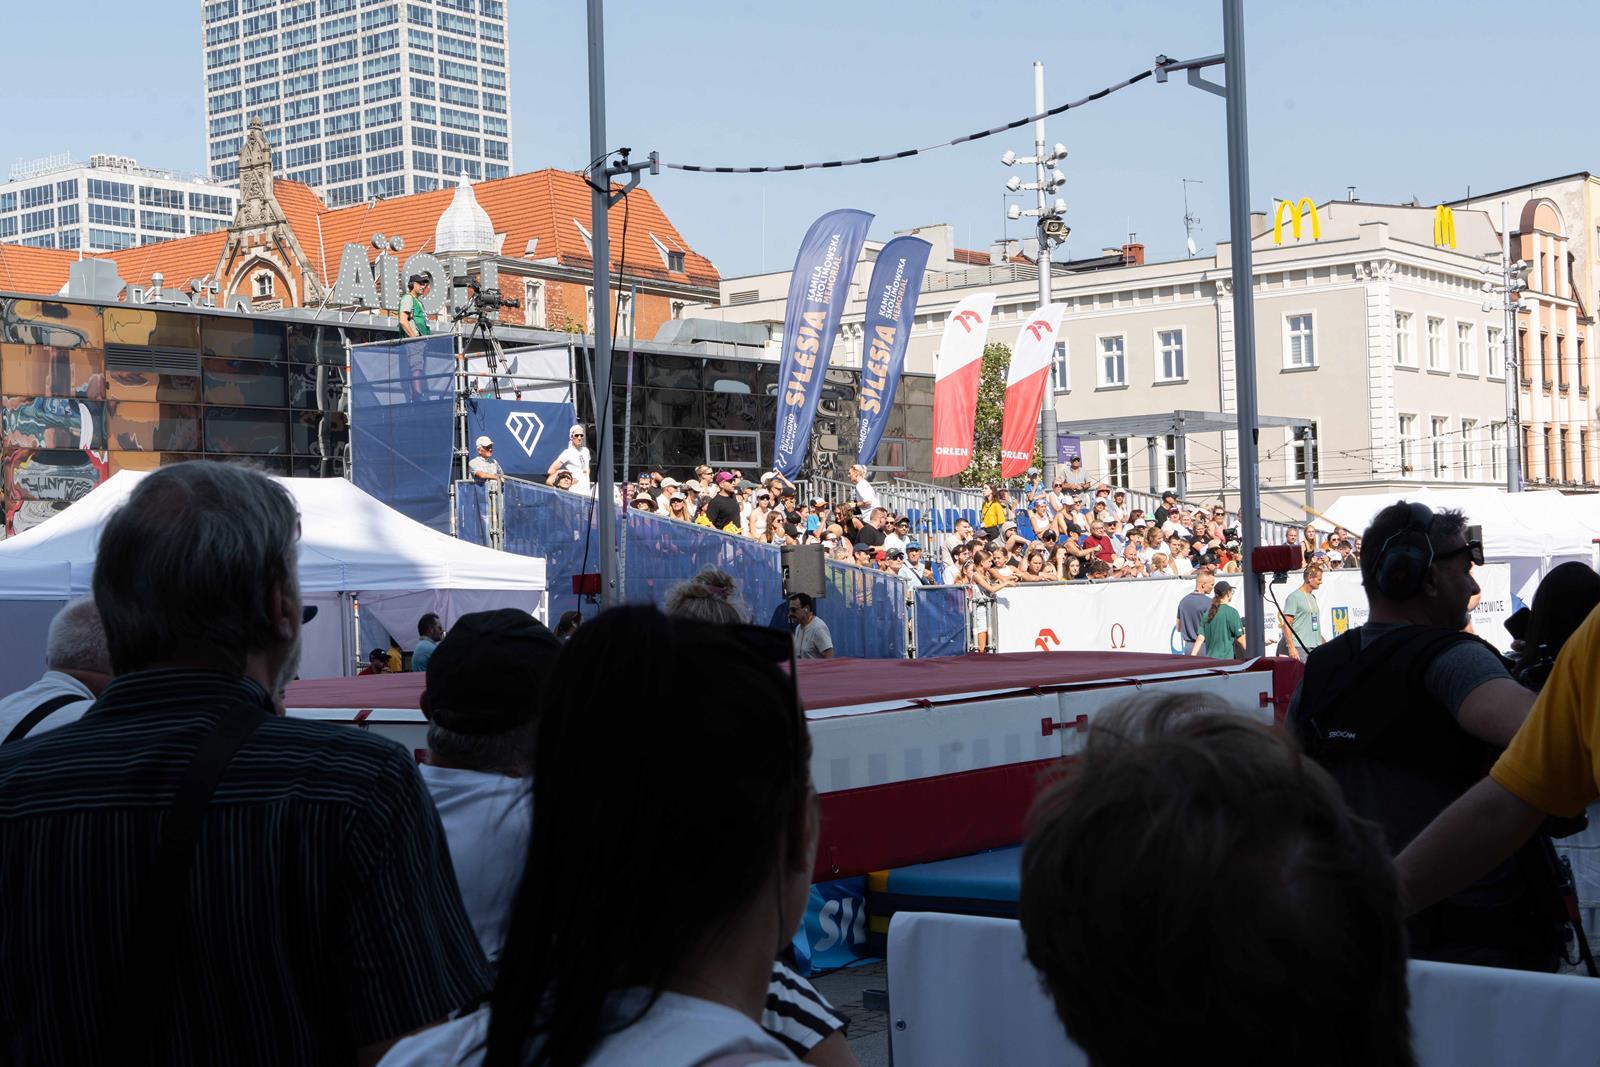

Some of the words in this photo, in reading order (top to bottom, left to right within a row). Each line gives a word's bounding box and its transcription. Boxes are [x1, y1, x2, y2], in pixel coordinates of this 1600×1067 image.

[806, 266, 823, 301] KAMILA
[815, 234, 840, 303] SKOLIMOWSKA
[823, 255, 842, 304] MEMORIAL
[886, 258, 906, 320] SKOLIMOWSKA
[879, 285, 892, 317] KAMILA
[892, 277, 908, 321] MEMORIAL
[786, 312, 827, 408] SILESIA
[859, 325, 897, 415] SILESIA
[935, 446, 968, 457] ORLEN
[1001, 450, 1029, 461] ORLEN
